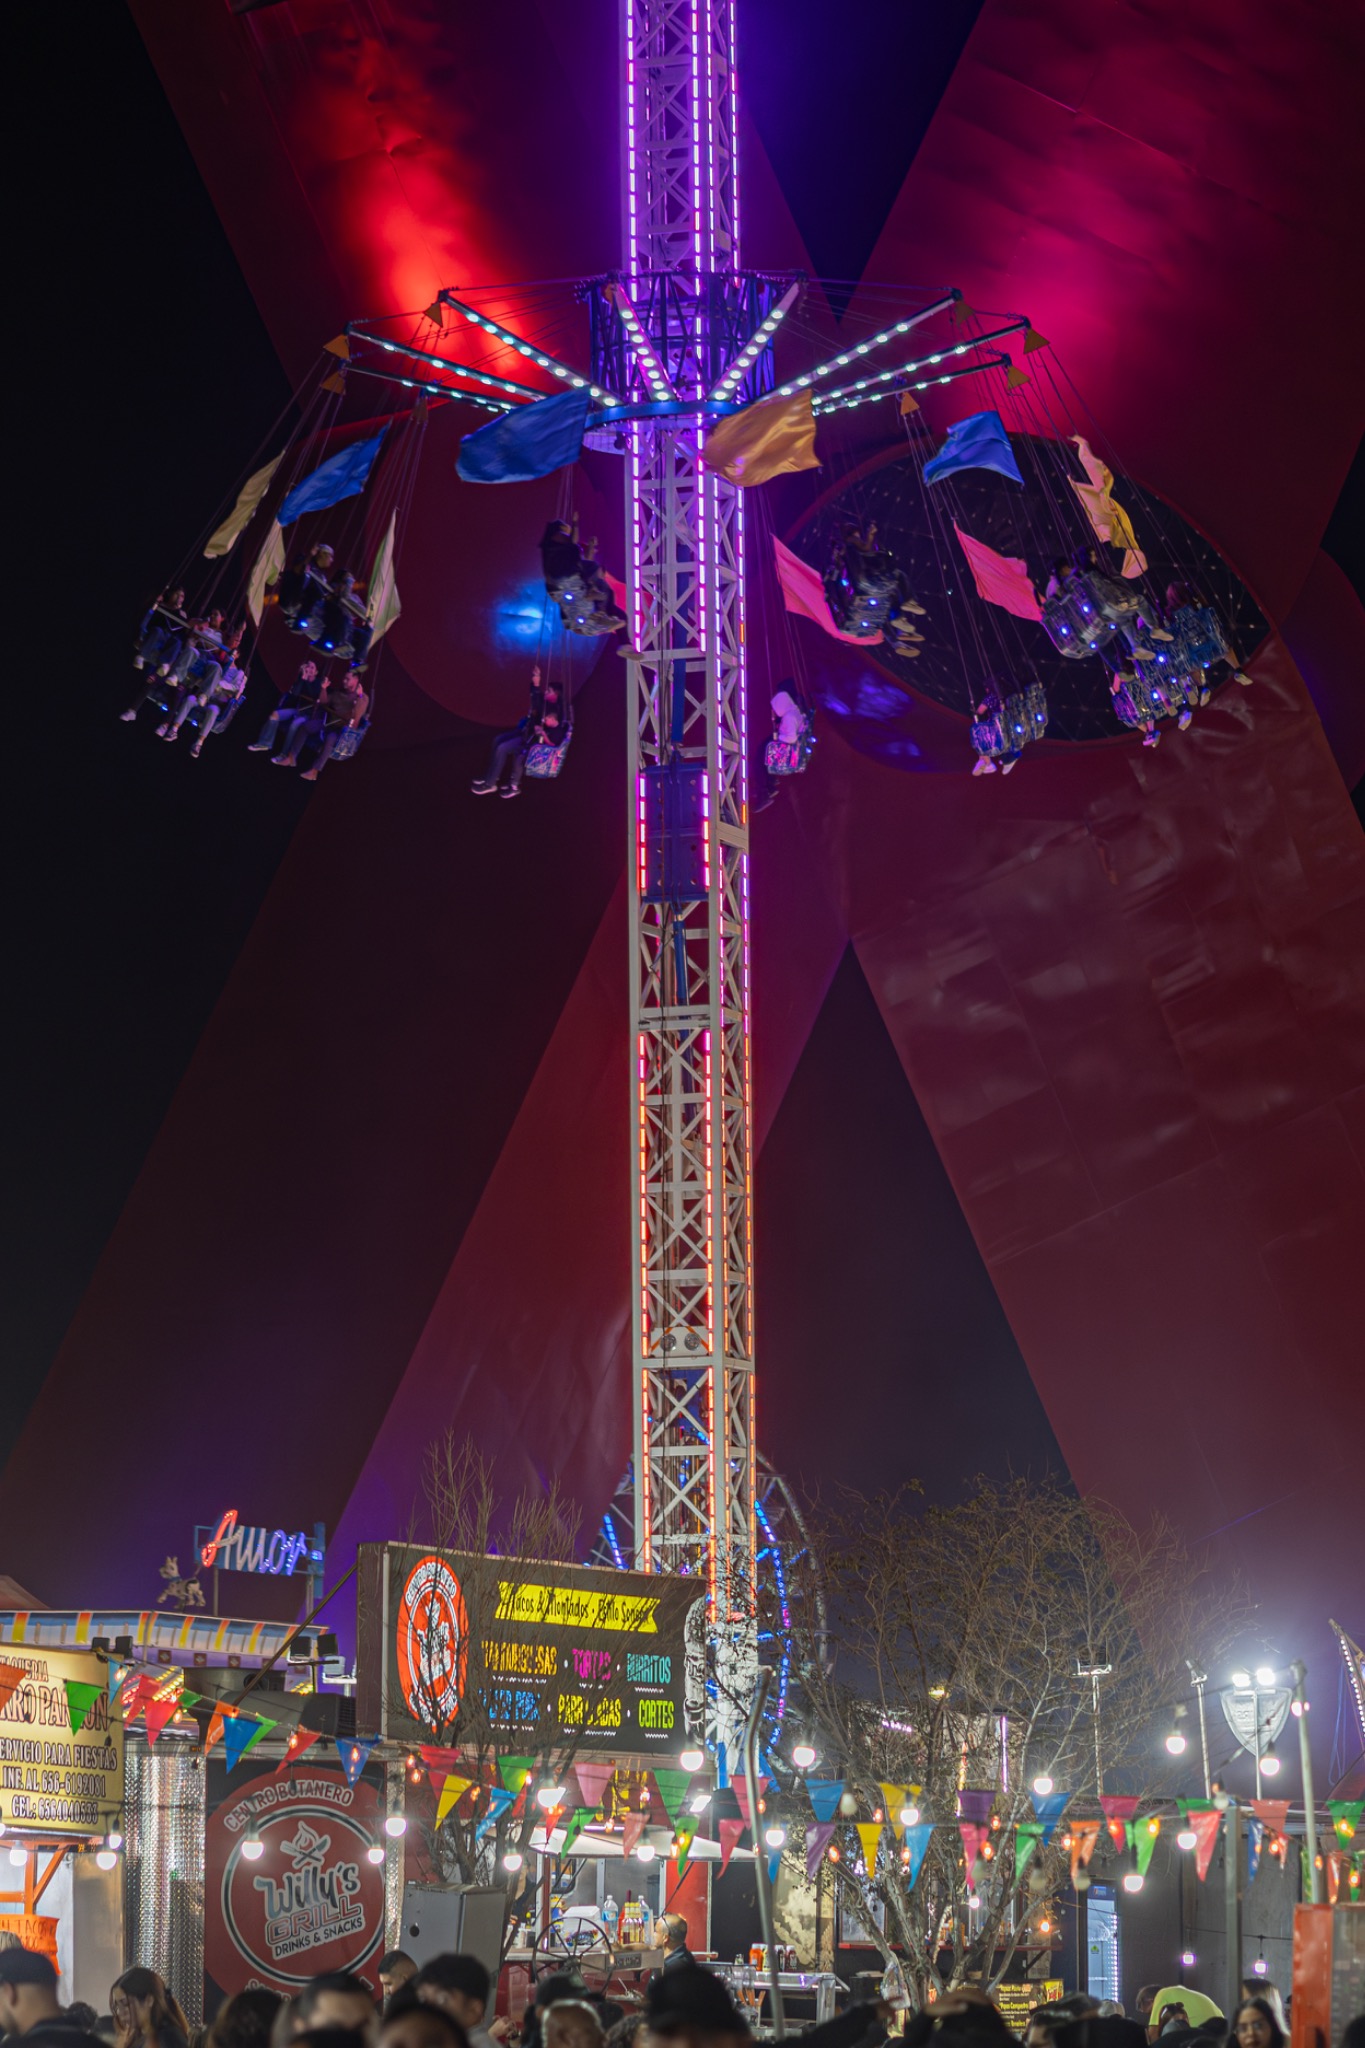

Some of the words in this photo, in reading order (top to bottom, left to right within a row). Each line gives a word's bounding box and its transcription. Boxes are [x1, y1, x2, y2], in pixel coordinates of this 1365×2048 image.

[201, 1509, 309, 1577] Amor
[626, 1653, 671, 1685] BURRITOS
[38, 1685, 109, 1732] PANON
[639, 1698, 675, 1729] CORTES
[44, 1742, 72, 1767] PARA
[73, 1745, 118, 1771] FIESTAS
[25, 1768, 40, 1793] AL
[41, 1770, 106, 1798] 656-6192081
[224, 1787, 277, 1831] CENTRO
[276, 1780, 354, 1806] BOTANERO
[254, 1864, 359, 1920] Willy's
[266, 1895, 361, 1945] GRILL
[275, 1935, 311, 1957] DRINKS
[313, 1932, 322, 1943] &
[323, 1917, 363, 1940] SNACKS
